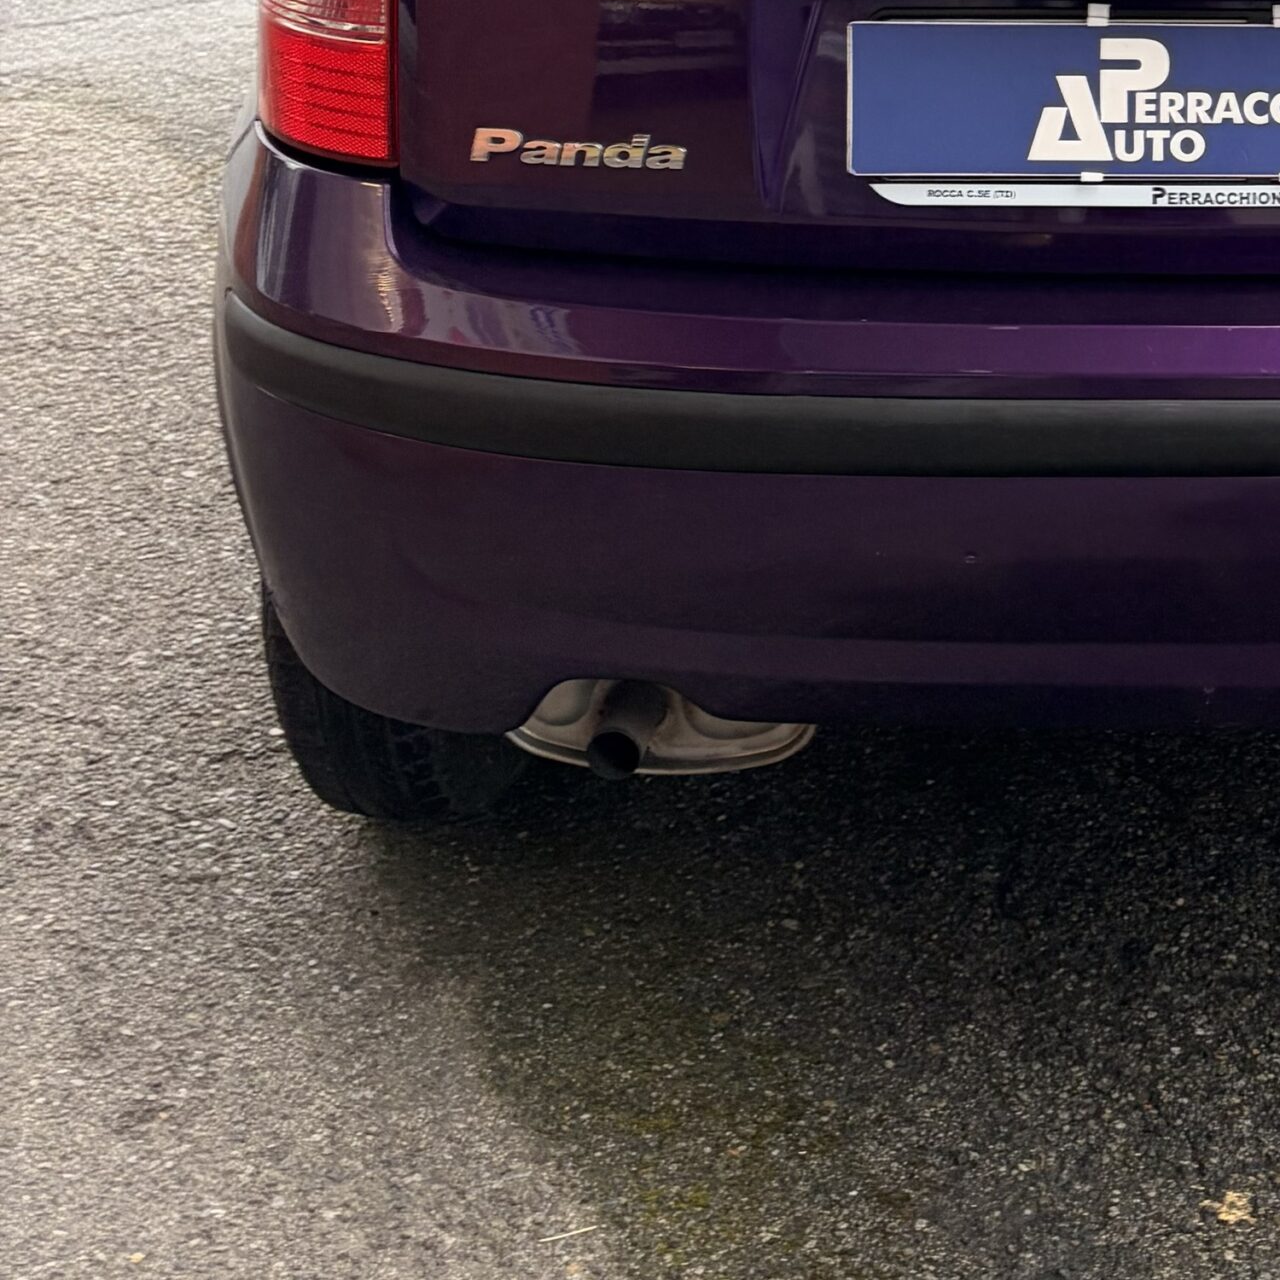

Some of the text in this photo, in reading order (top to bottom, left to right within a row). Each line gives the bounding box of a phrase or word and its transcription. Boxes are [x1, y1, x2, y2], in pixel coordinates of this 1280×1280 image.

[1027, 75, 1206, 162] AUTO
[469, 127, 688, 170] Panda
[927, 189, 964, 198] ROCCA
